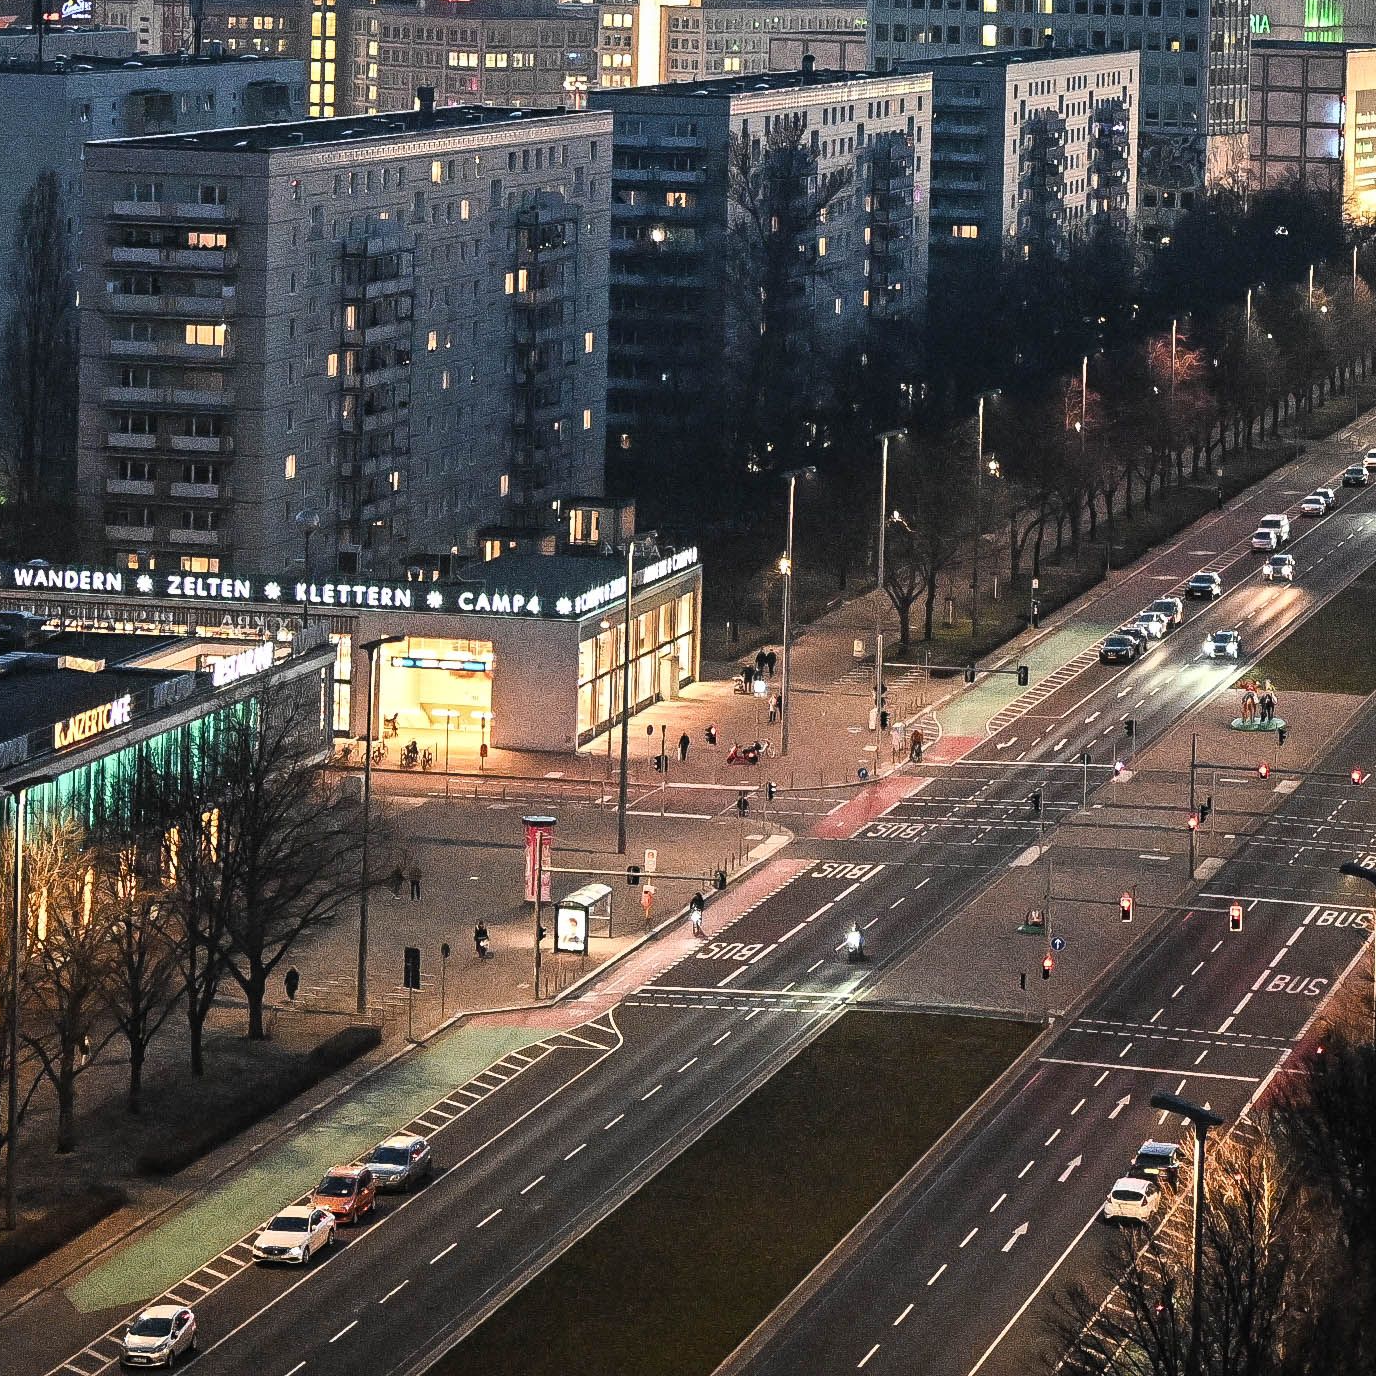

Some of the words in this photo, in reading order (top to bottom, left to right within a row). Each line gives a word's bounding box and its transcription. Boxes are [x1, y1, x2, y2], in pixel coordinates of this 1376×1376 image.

[14, 568, 122, 591] WANDERN
[167, 575, 251, 599] ZELTEN
[295, 582, 412, 608] KLETTERN
[458, 591, 541, 614] CAMP4
[866, 822, 925, 839] BUS
[811, 862, 873, 879] BUS
[1316, 910, 1374, 929] BUS
[696, 942, 764, 961] BUS
[1265, 974, 1328, 995] BUS
